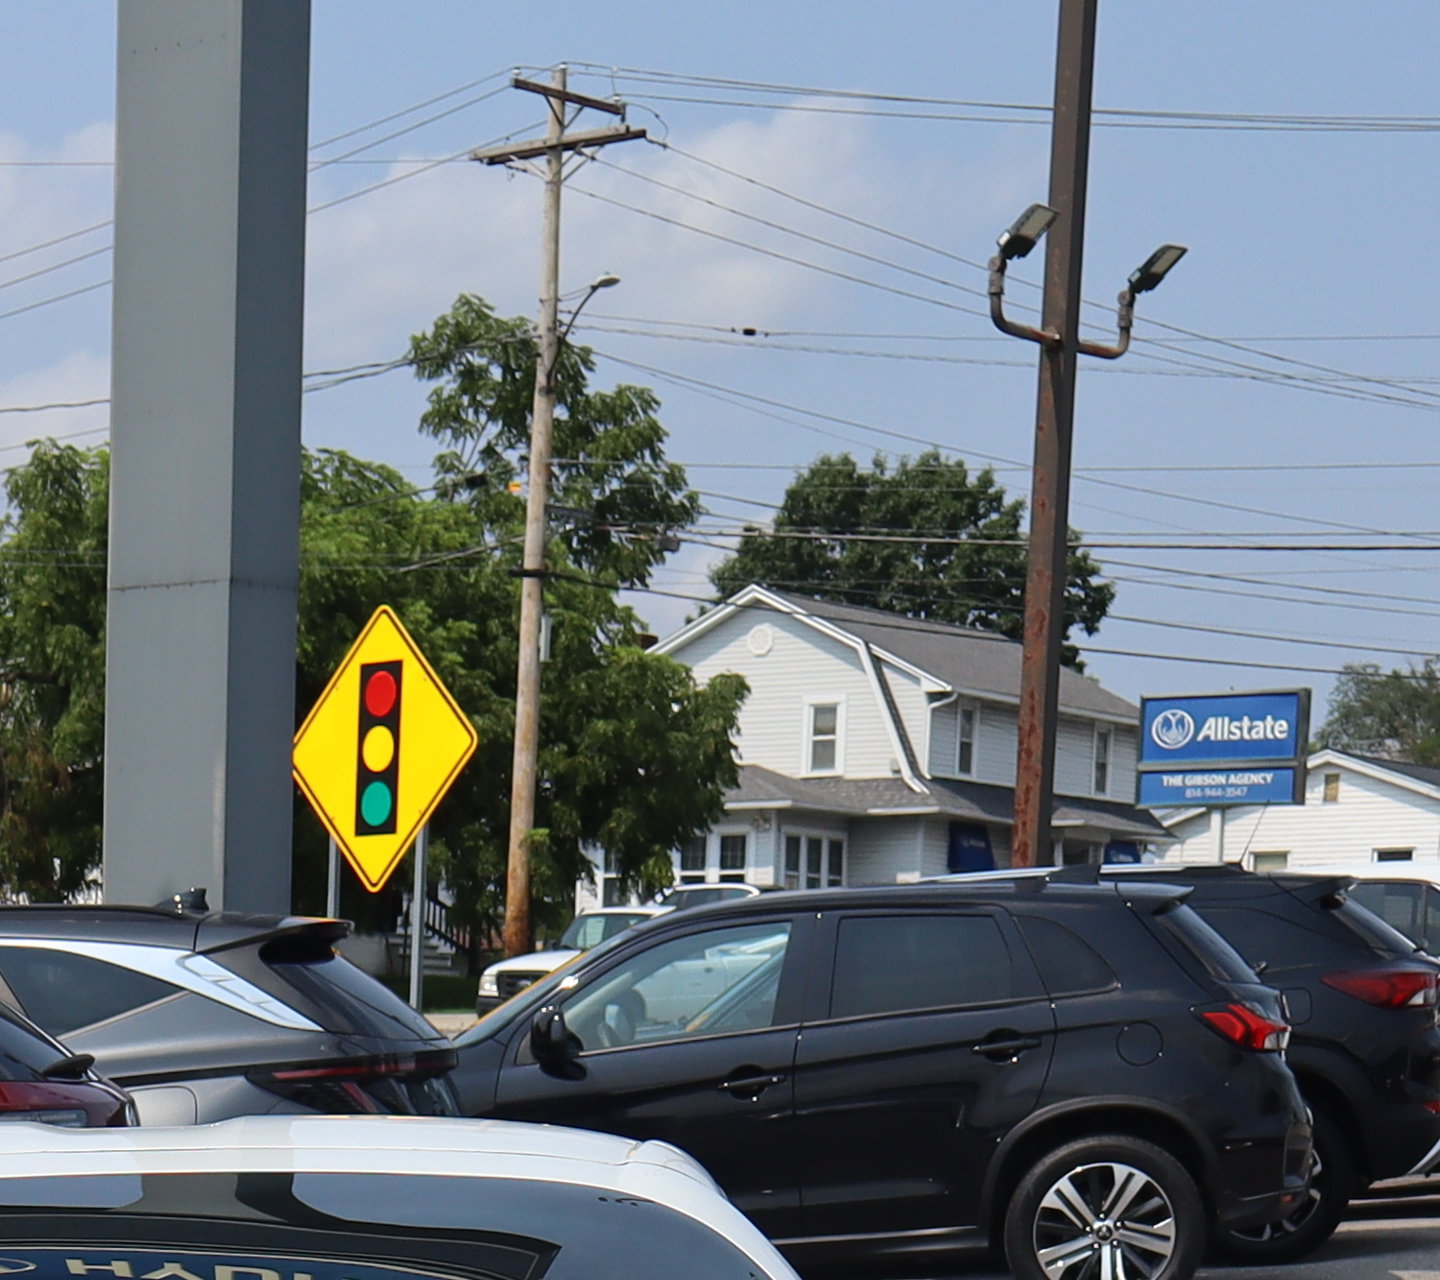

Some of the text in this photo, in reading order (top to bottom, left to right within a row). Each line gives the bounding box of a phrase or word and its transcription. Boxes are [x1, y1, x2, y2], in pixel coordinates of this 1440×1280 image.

[1197, 715, 1289, 741] Allstate
[1162, 772, 1274, 787] THE GIBSON AGENCY
